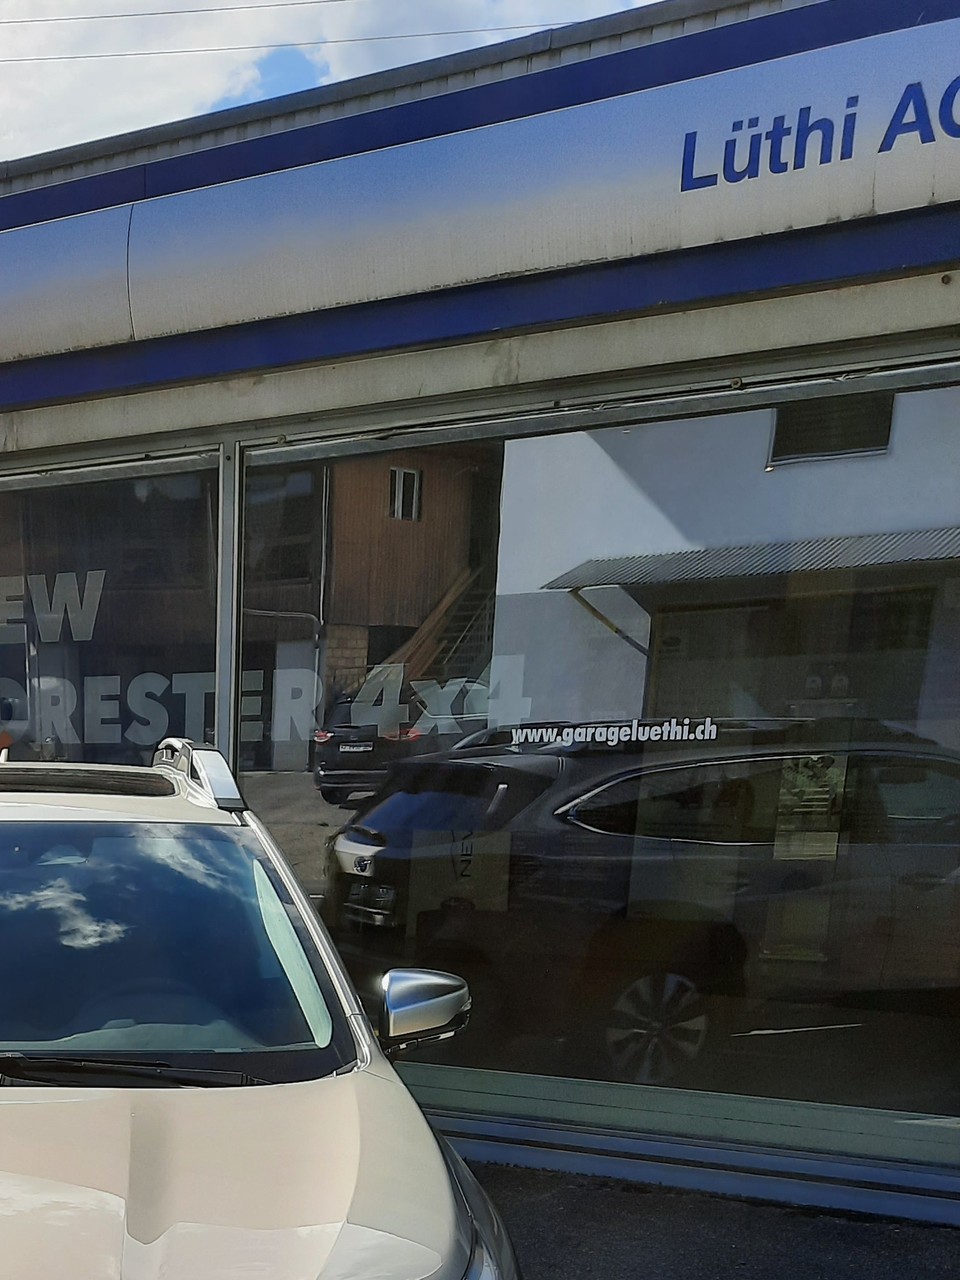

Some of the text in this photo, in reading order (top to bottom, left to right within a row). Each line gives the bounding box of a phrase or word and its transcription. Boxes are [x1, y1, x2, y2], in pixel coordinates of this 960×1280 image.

[680, 95, 859, 192] Lüthi
[351, 654, 533, 738] 4x4
[511, 717, 718, 747] www.garageluethi.ch
